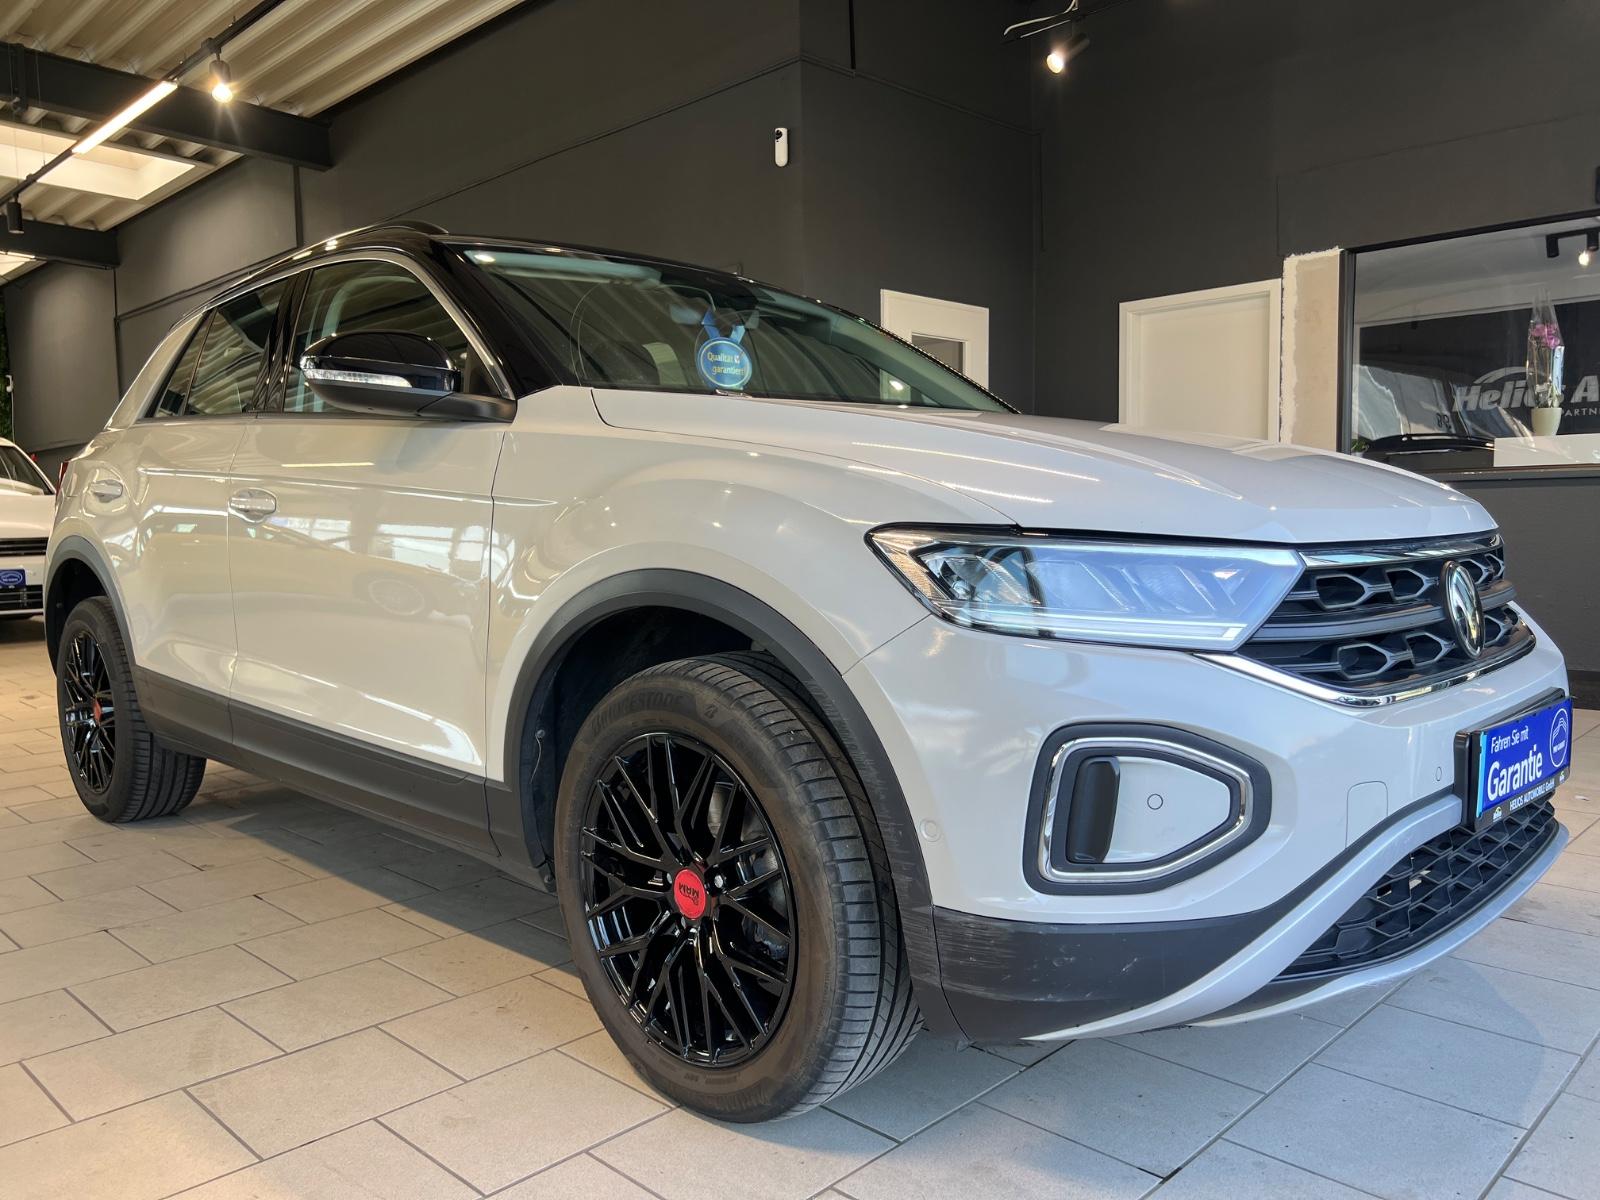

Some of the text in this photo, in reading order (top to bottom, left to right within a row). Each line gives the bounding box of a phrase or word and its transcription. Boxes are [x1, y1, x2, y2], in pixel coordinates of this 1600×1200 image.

[1452, 380, 1565, 412] Heli
[1561, 407, 1600, 417] ARTN
[1491, 725, 1529, 754] Fahren Sie mit
[1487, 744, 1543, 801] Garantie
[1510, 795, 1523, 811] HELIOS
